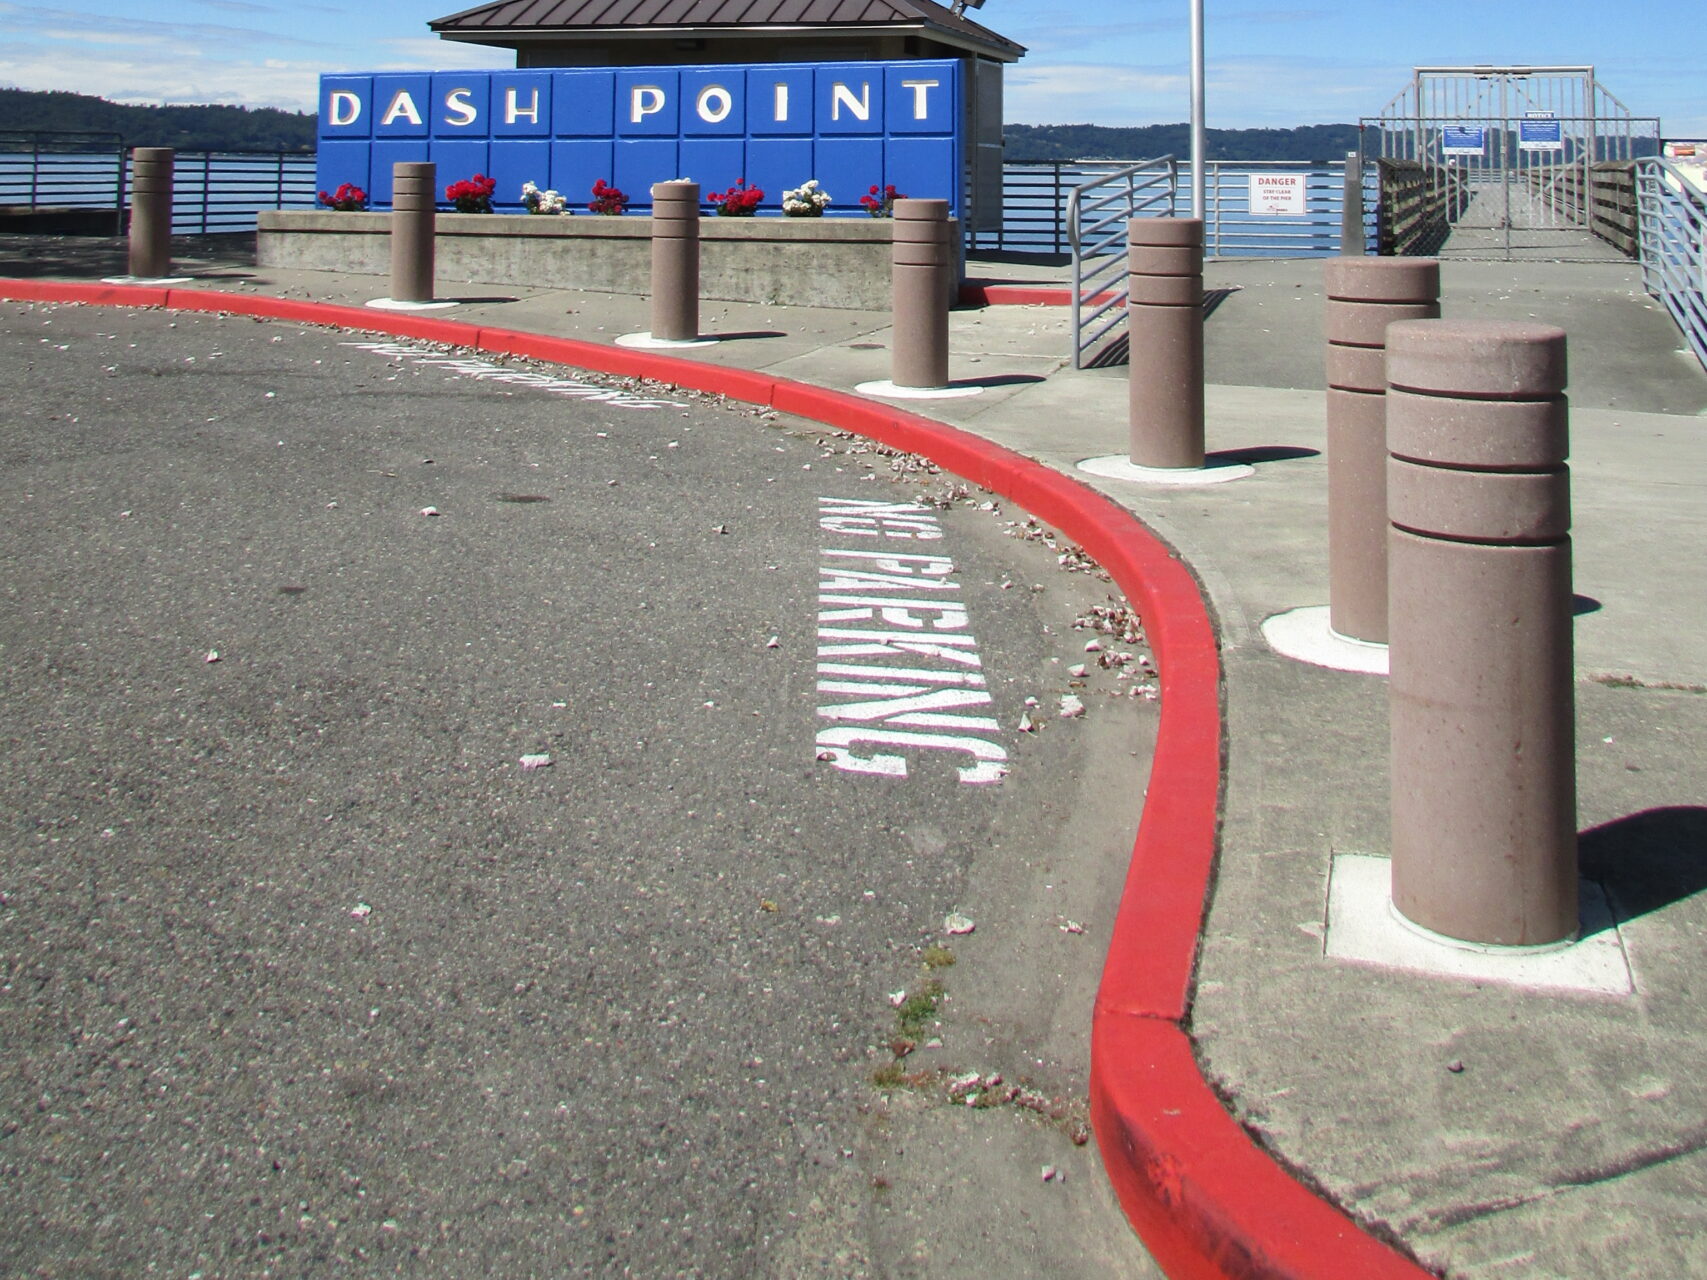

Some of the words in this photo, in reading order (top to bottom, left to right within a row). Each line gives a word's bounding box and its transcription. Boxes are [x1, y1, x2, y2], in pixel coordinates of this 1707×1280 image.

[329, 88, 538, 126] DASH
[631, 80, 939, 124] POINT
[1258, 177, 1297, 186] DANGER
[818, 496, 943, 540] NO
[816, 548, 1008, 785] PARKING
